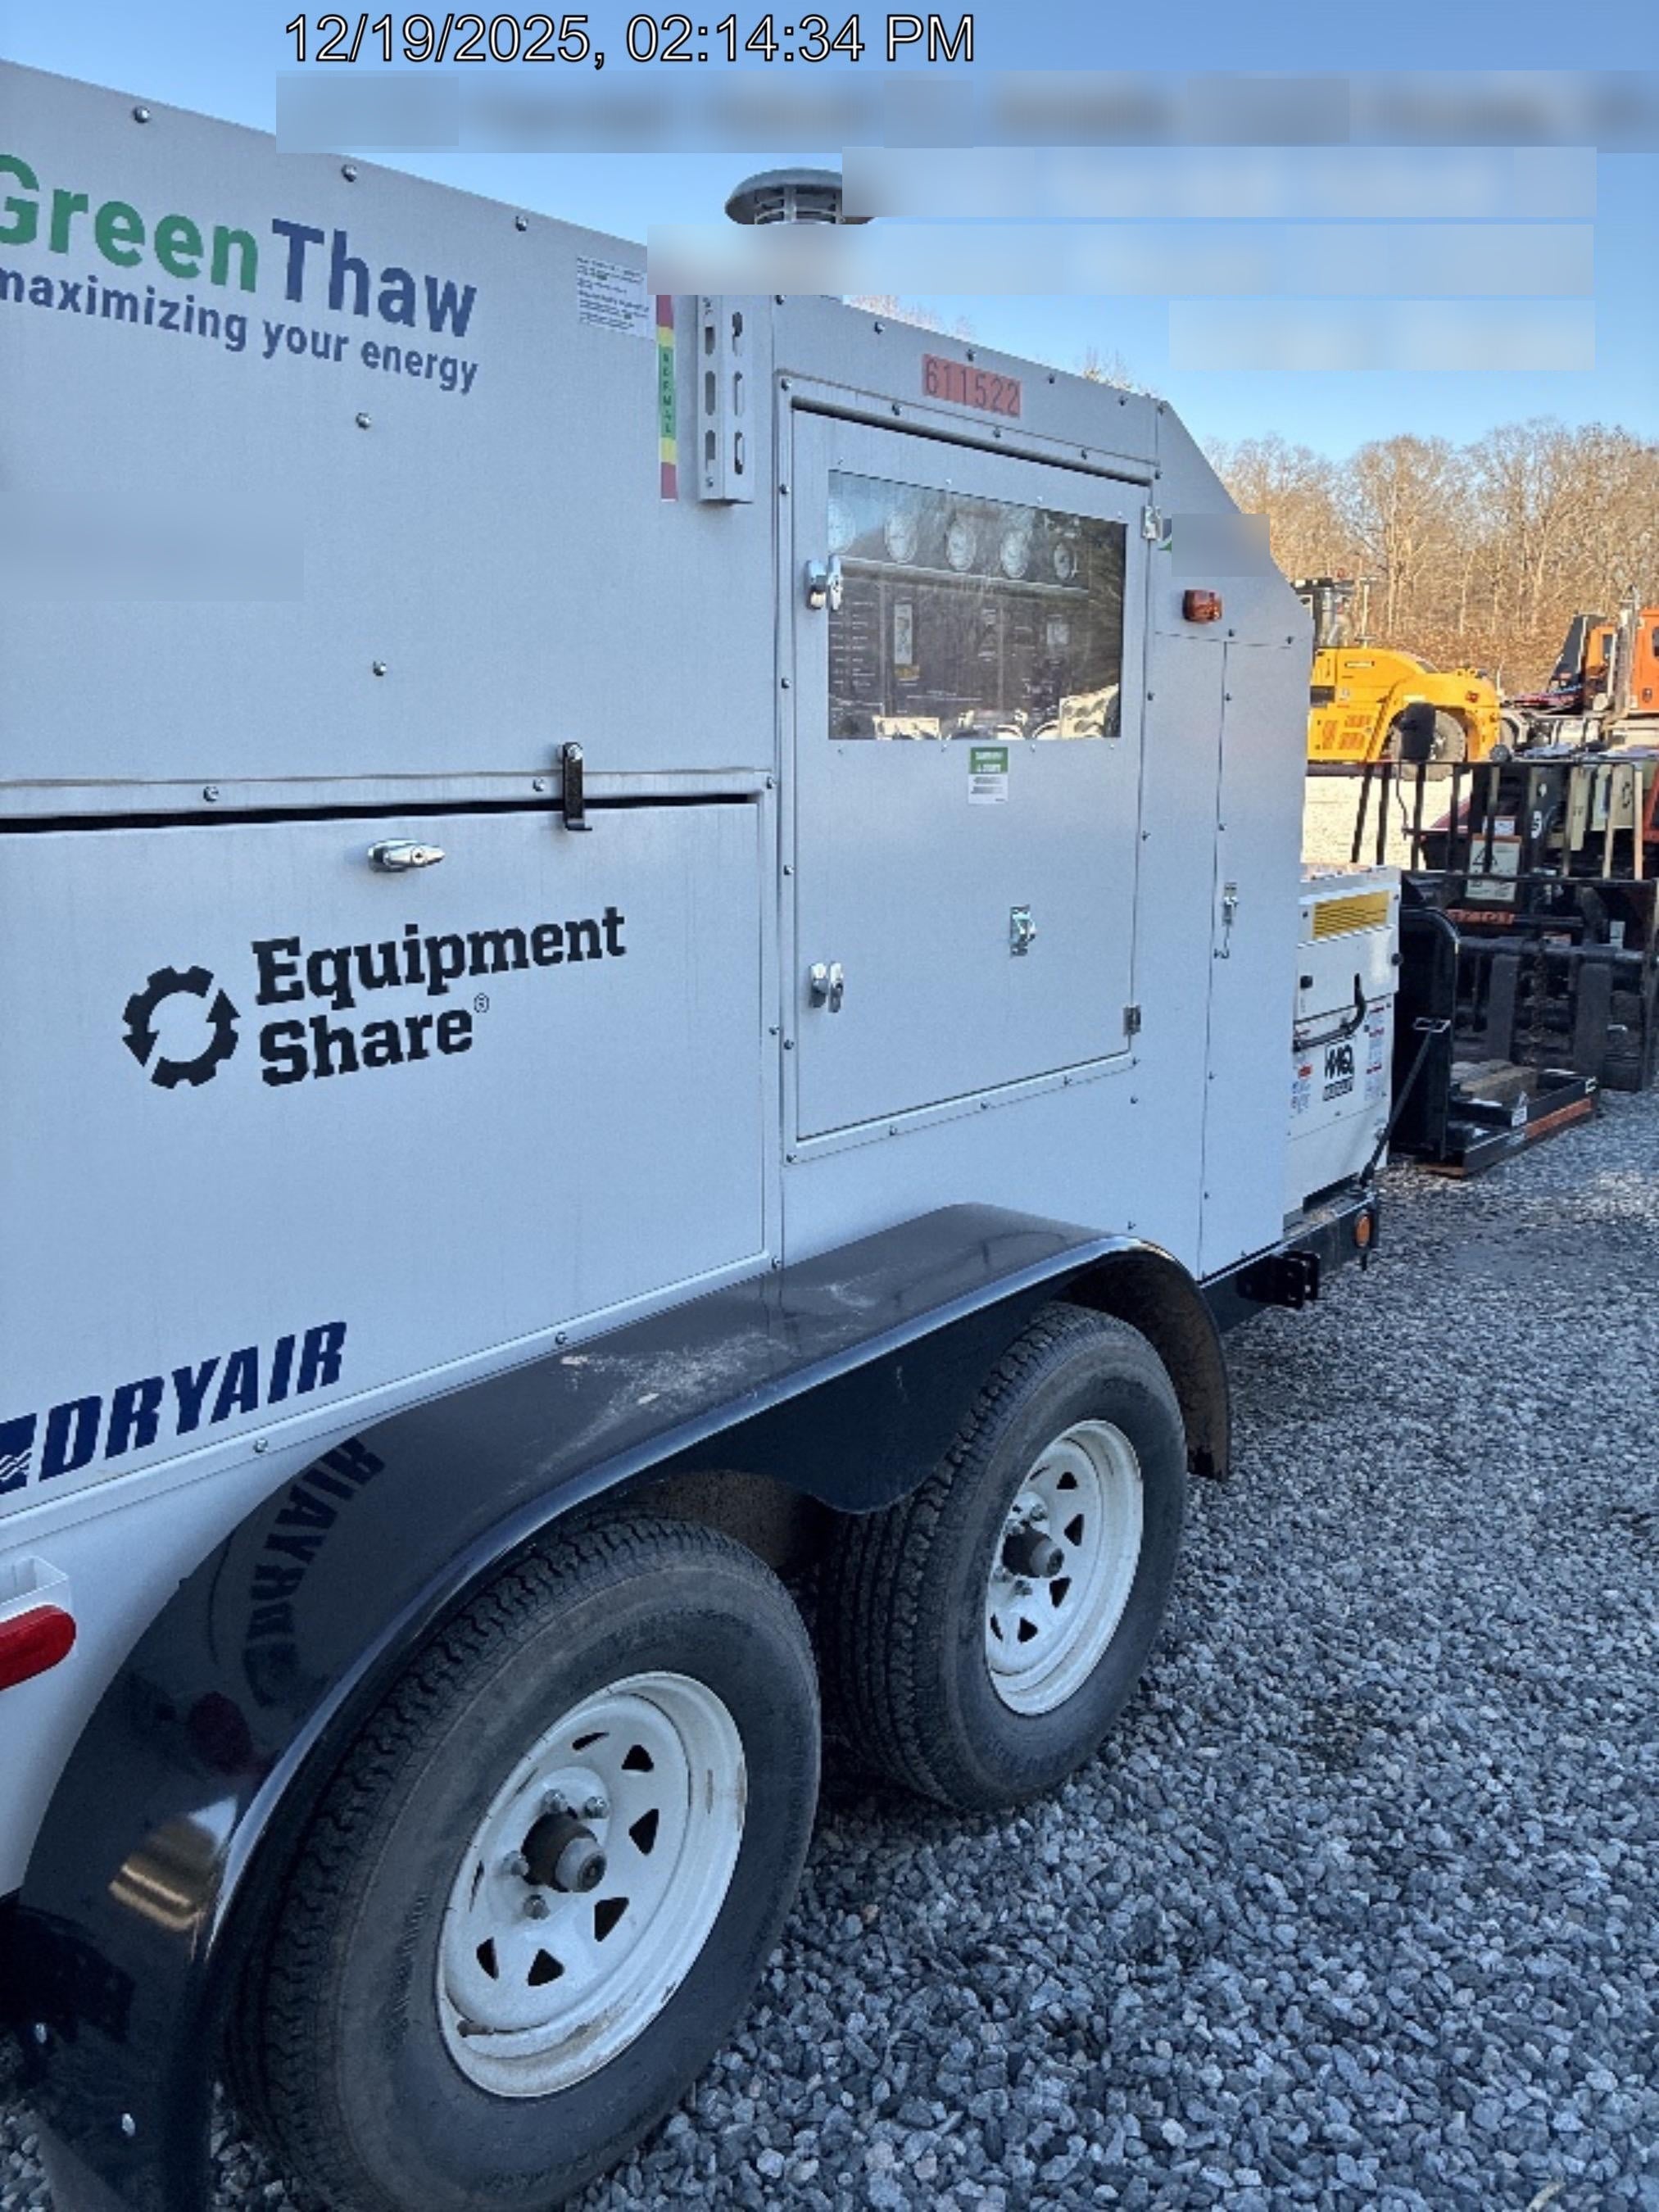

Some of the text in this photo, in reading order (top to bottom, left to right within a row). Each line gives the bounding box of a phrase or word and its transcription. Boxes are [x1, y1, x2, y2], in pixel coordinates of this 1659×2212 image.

[262, 319, 348, 359] your
[361, 339, 478, 394] energy
[926, 359, 1020, 418] 611522
[252, 906, 627, 1010] Equipment
[39, 1321, 347, 1481] DRYAIR
